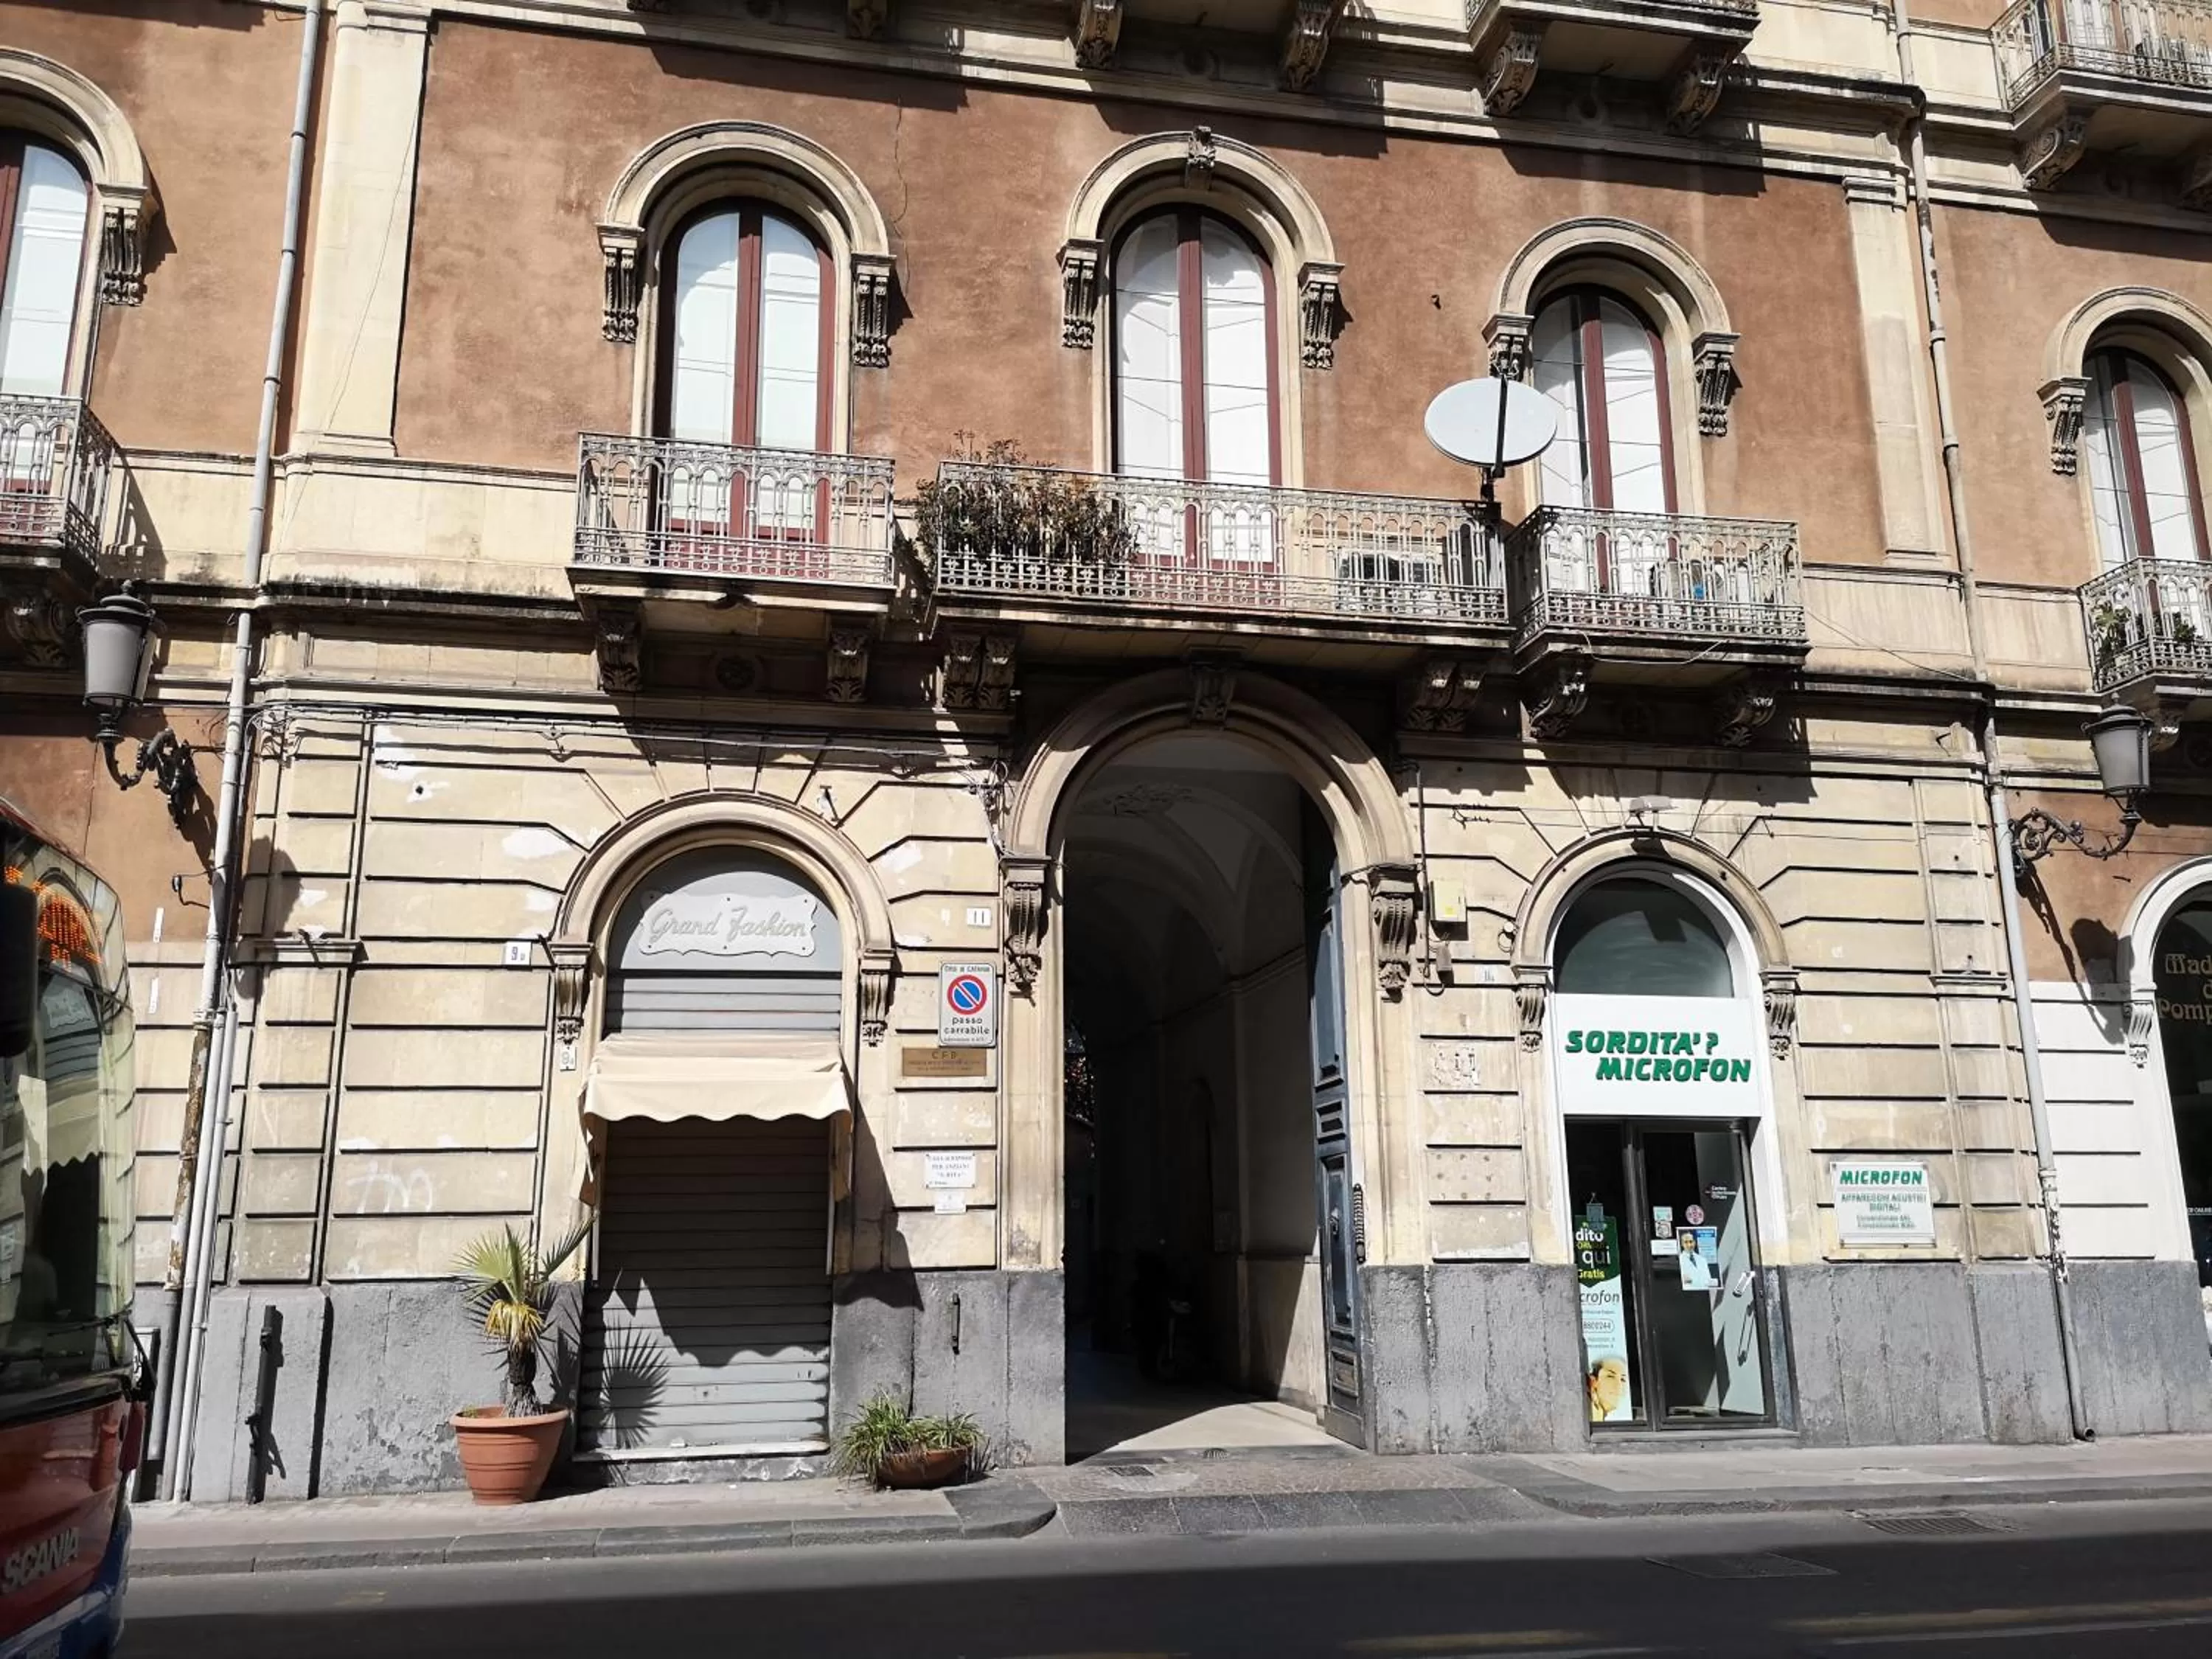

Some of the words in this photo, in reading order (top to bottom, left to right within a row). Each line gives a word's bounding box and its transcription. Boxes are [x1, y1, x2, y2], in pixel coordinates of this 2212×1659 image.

[650, 908, 722, 943] Grand
[727, 905, 807, 942] Fashion
[973, 911, 985, 924] 11
[944, 1026, 990, 1034] carrabile
[952, 1017, 983, 1026] passo
[1596, 1057, 1751, 1082] MICROFON
[1840, 1170, 1923, 1185] MICROFON
[1582, 1245, 1611, 1268] qui
[2, 1527, 80, 1593] SCANIA
